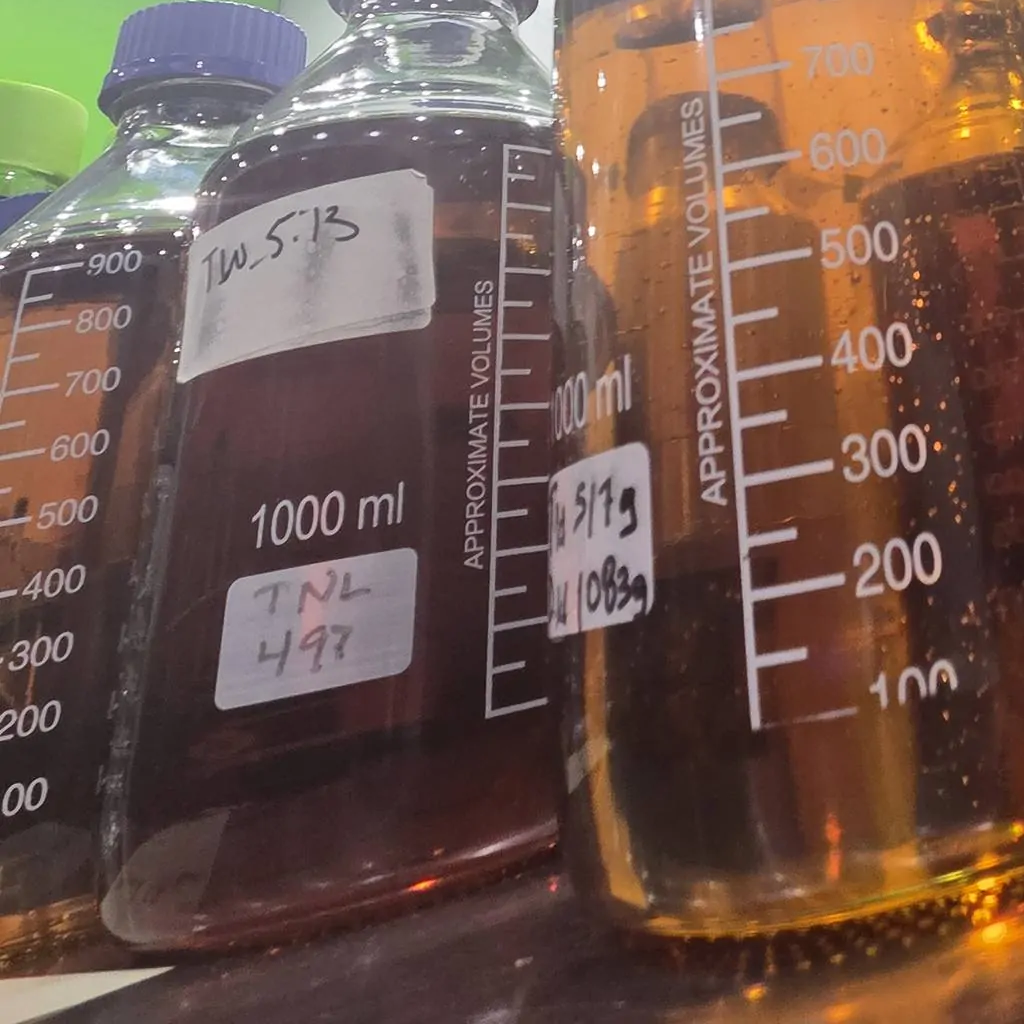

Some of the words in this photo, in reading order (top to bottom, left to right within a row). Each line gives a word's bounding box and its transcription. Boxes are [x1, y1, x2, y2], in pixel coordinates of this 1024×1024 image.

[803, 41, 875, 78] 700
[680, 97, 710, 241] VOLUMES
[809, 127, 888, 172] 600
[87, 250, 142, 276] 900
[820, 220, 899, 269] 500
[75, 304, 132, 333] 800
[470, 279, 494, 389] VOLUMES
[831, 322, 915, 375] 400
[65, 366, 121, 397] 700
[596, 353, 632, 420] ml
[688, 249, 728, 507] APPROXIMATE
[50, 429, 111, 462] 600
[841, 423, 928, 484] 300
[464, 392, 490, 570] APPROXIMATE
[37, 495, 99, 530] 500
[251, 490, 345, 549] 1000
[357, 481, 405, 530] ml
[21, 564, 86, 601] 400
[853, 531, 943, 598] 200
[8, 631, 74, 672] 300
[0, 699, 62, 742] 200
[0, 776, 48, 817] 00
